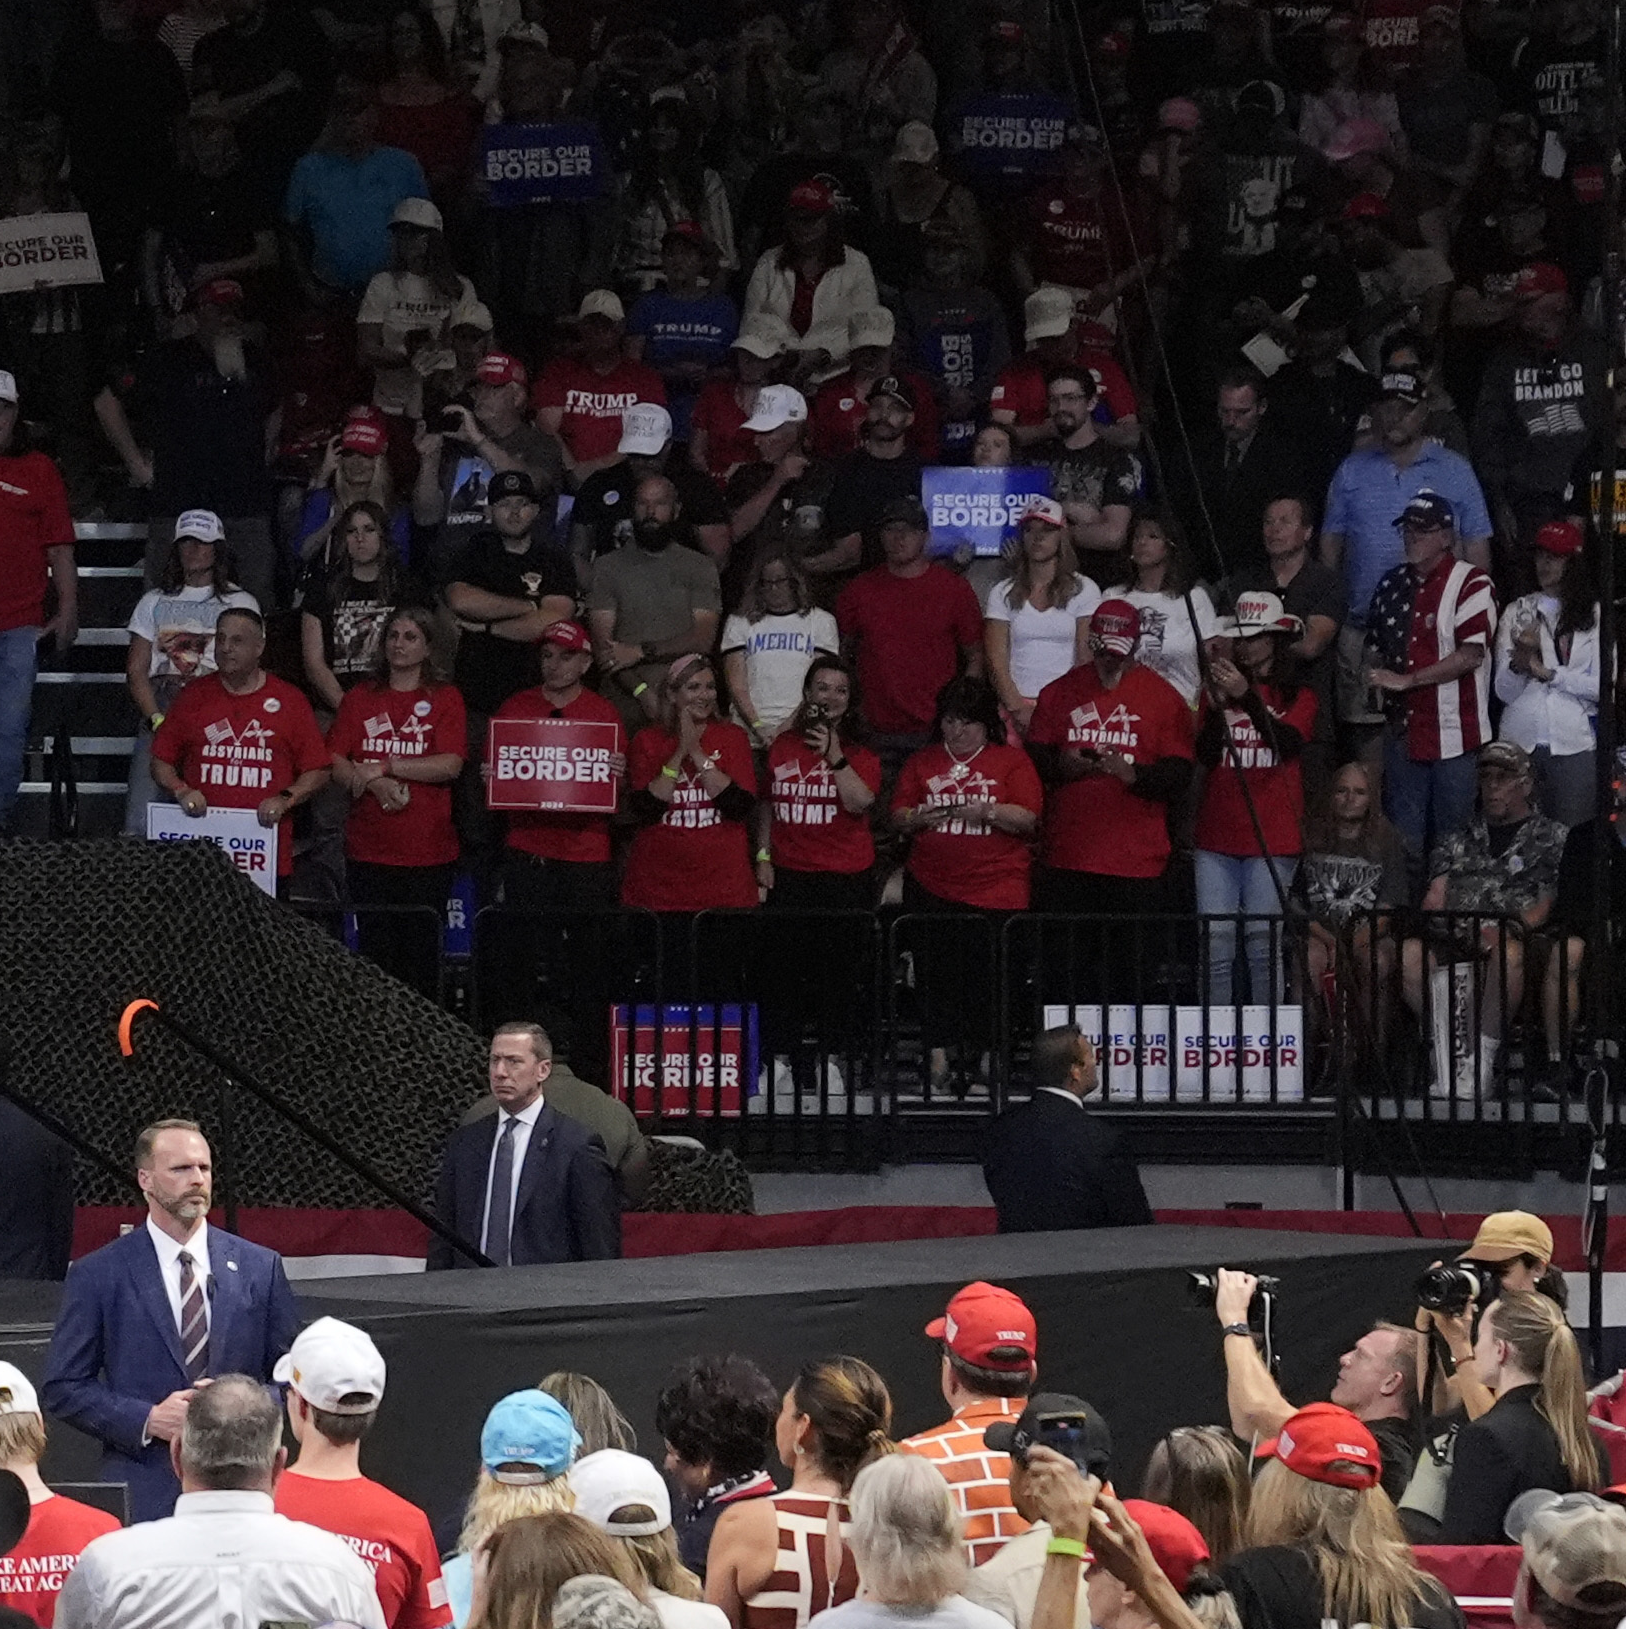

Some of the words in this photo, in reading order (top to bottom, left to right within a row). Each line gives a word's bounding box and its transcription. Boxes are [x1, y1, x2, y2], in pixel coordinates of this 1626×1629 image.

[964, 116, 1019, 132] SECURE
[1027, 118, 1064, 131] OUR
[963, 129, 1064, 150] BORDER
[486, 147, 550, 165] SECURE
[556, 145, 590, 161] OUR
[486, 158, 592, 181] BORDER
[49, 234, 83, 250] OUR
[1515, 380, 1584, 401] BRANDON
[566, 390, 637, 409] TRUMP
[1068, 728, 1138, 745] ASSYRIANS
[202, 745, 272, 761] ASSYRIANS
[499, 745, 566, 760] SECURE
[573, 747, 610, 761] OUR
[200, 763, 272, 788] TRUMP
[497, 759, 611, 782] BORDER
[229, 837, 265, 852] OUR
[995, 1330, 1028, 1342] TRUMP
[504, 1446, 537, 1457] TRUMP
